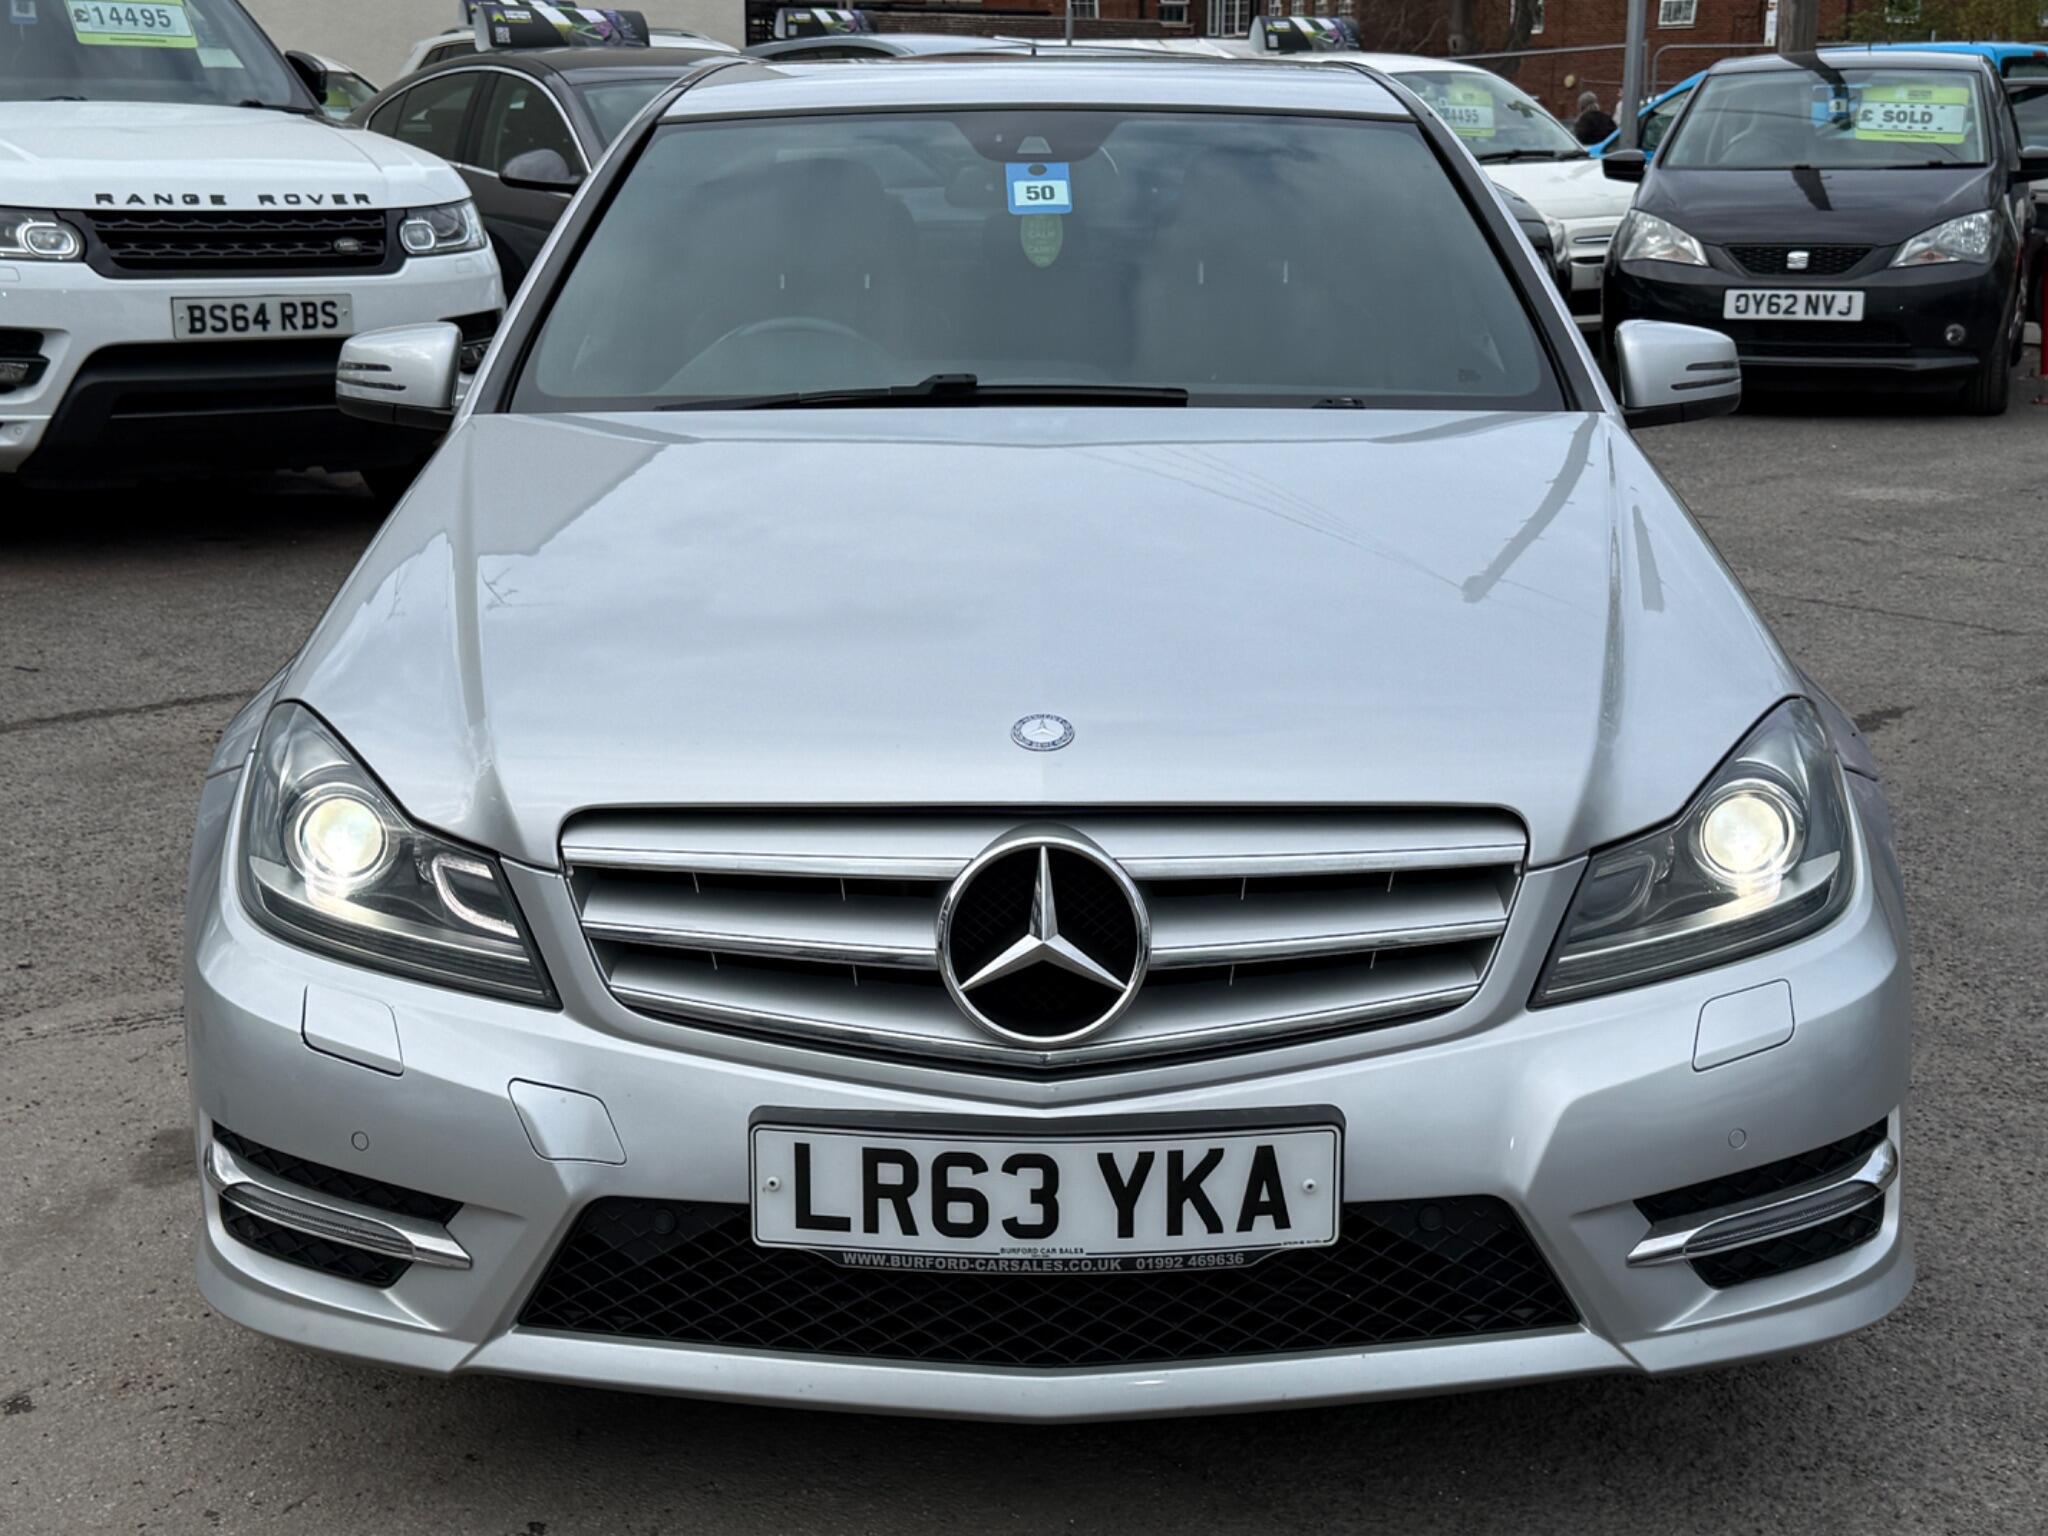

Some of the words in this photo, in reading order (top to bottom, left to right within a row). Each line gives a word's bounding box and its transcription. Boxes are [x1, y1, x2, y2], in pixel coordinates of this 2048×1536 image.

[73, 6, 172, 28] £14495
[1861, 109, 1874, 122] £
[1882, 110, 1933, 124] SOLD
[95, 194, 228, 206] RANGE
[257, 192, 371, 206] ROVER
[1026, 185, 1055, 201] 50
[1734, 293, 1798, 315] OY62
[1804, 294, 1853, 316] NVJ
[187, 303, 271, 334] BS64
[280, 301, 338, 331] RBS
[793, 1141, 1060, 1240] LR63
[1096, 1144, 1292, 1239] YKA
[1040, 1247, 1057, 1255] CAR
[1059, 1247, 1084, 1255] SALES
[843, 1252, 1121, 1272] WWW.BURFORD-CARSALES.CO.UK
[1135, 1257, 1184, 1270] 01992
[1187, 1252, 1245, 1267] 469636
